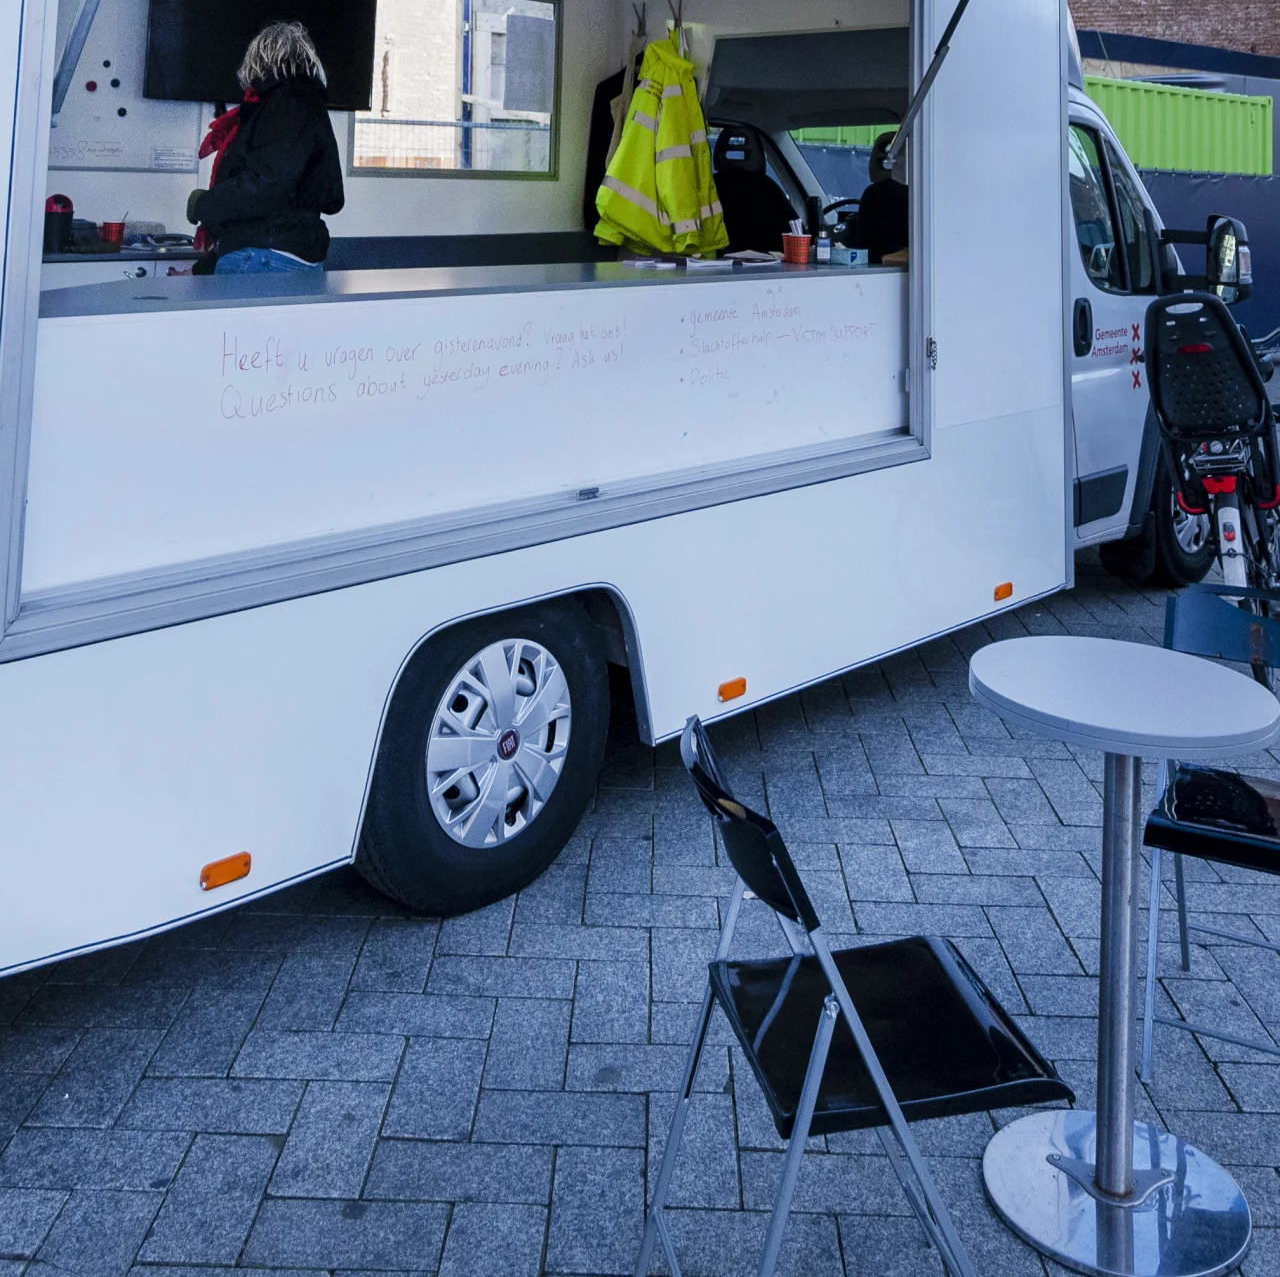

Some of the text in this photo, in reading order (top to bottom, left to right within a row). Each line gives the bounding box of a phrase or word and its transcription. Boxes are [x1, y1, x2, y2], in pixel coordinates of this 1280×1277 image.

[752, 303, 801, 321] Amsterdam
[830, 322, 879, 342] SUPPORT
[1095, 327, 1128, 341] Gemeente
[222, 331, 284, 377] Heeft
[298, 351, 309, 372] u
[325, 345, 374, 380] vragen
[386, 343, 421, 362] over
[543, 326, 574, 350] Vraag
[580, 324, 596, 339] het
[1091, 341, 1128, 357] Amsterdam
[220, 382, 338, 420] Questions
[357, 373, 407, 398] about
[417, 362, 490, 400] yesterday
[571, 349, 596, 370] Ask
[604, 342, 625, 363] us!
[502, 735, 515, 753] FIAT
